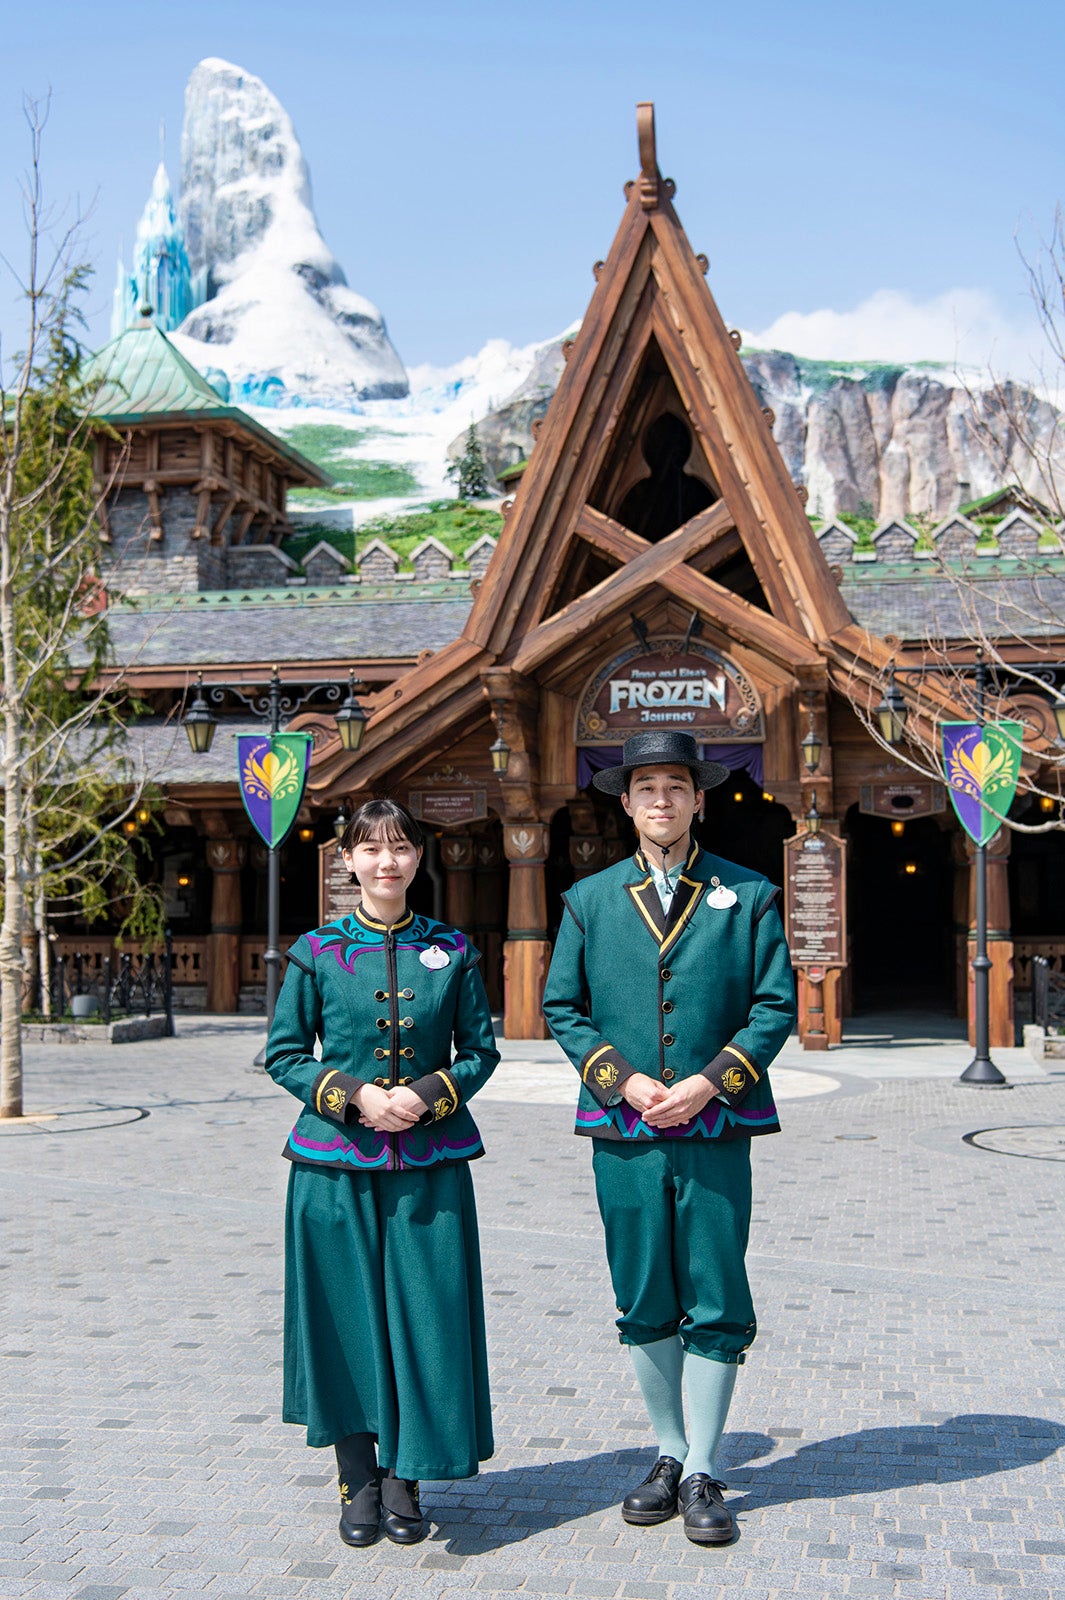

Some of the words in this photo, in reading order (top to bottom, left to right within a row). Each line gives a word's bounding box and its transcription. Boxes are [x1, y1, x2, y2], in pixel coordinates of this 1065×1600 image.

[631, 669, 656, 678] Anna
[659, 669, 676, 677] and
[680, 668, 707, 677] Elsa's
[609, 677, 726, 713] FROZEN
[641, 711, 695, 722] Journey
